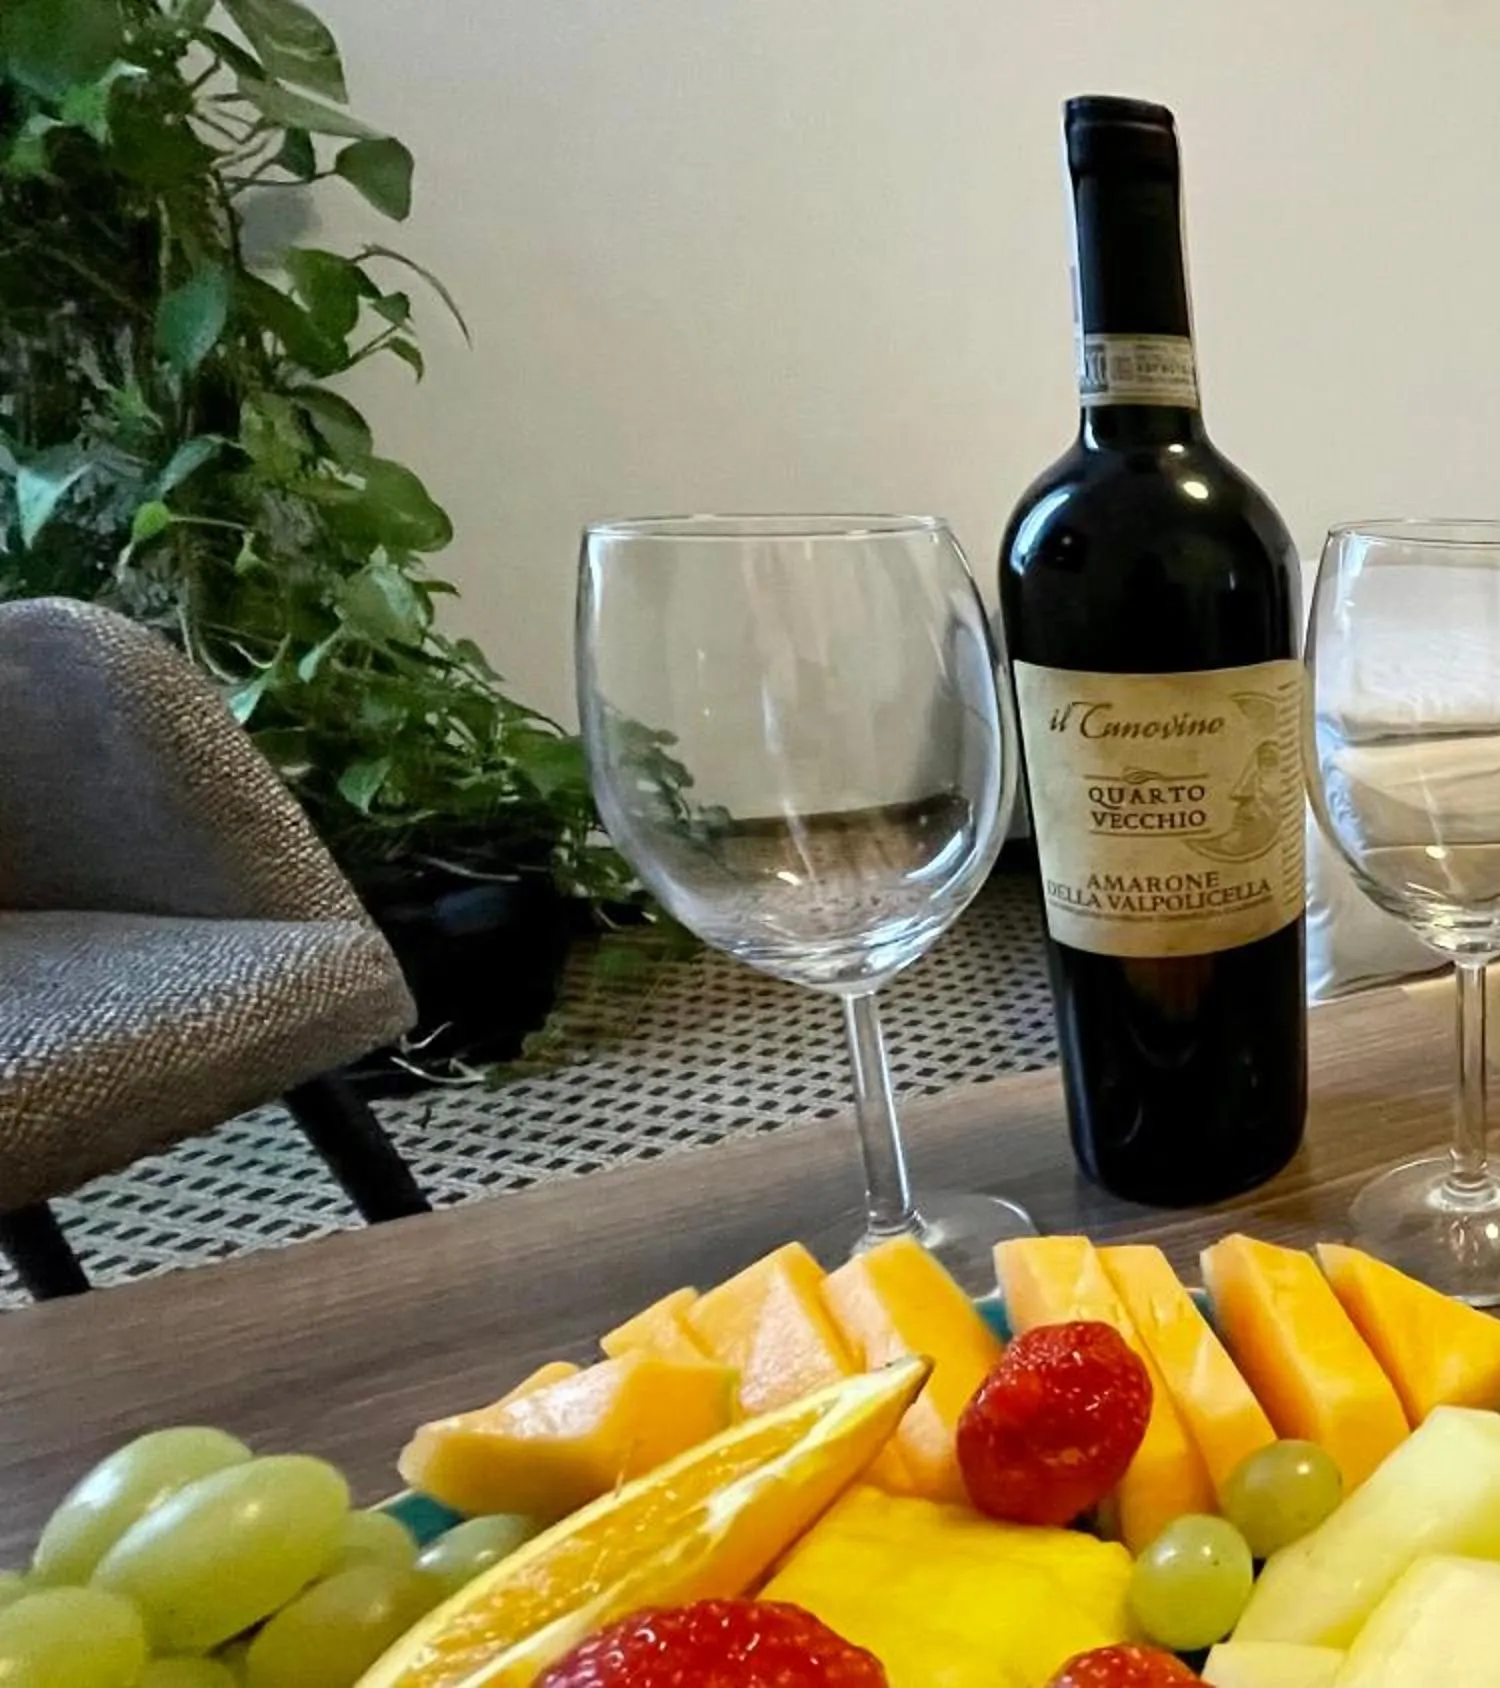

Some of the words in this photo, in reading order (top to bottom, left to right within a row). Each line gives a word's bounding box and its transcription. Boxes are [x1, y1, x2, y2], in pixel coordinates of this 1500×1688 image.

[1049, 703, 1072, 732] il
[1088, 785, 1205, 810] QUARTO
[1090, 809, 1206, 829] VECCHIO
[1087, 871, 1220, 893] AMARONE
[1047, 880, 1102, 908] DELLA
[1107, 879, 1271, 912] VALPOLICELLA
